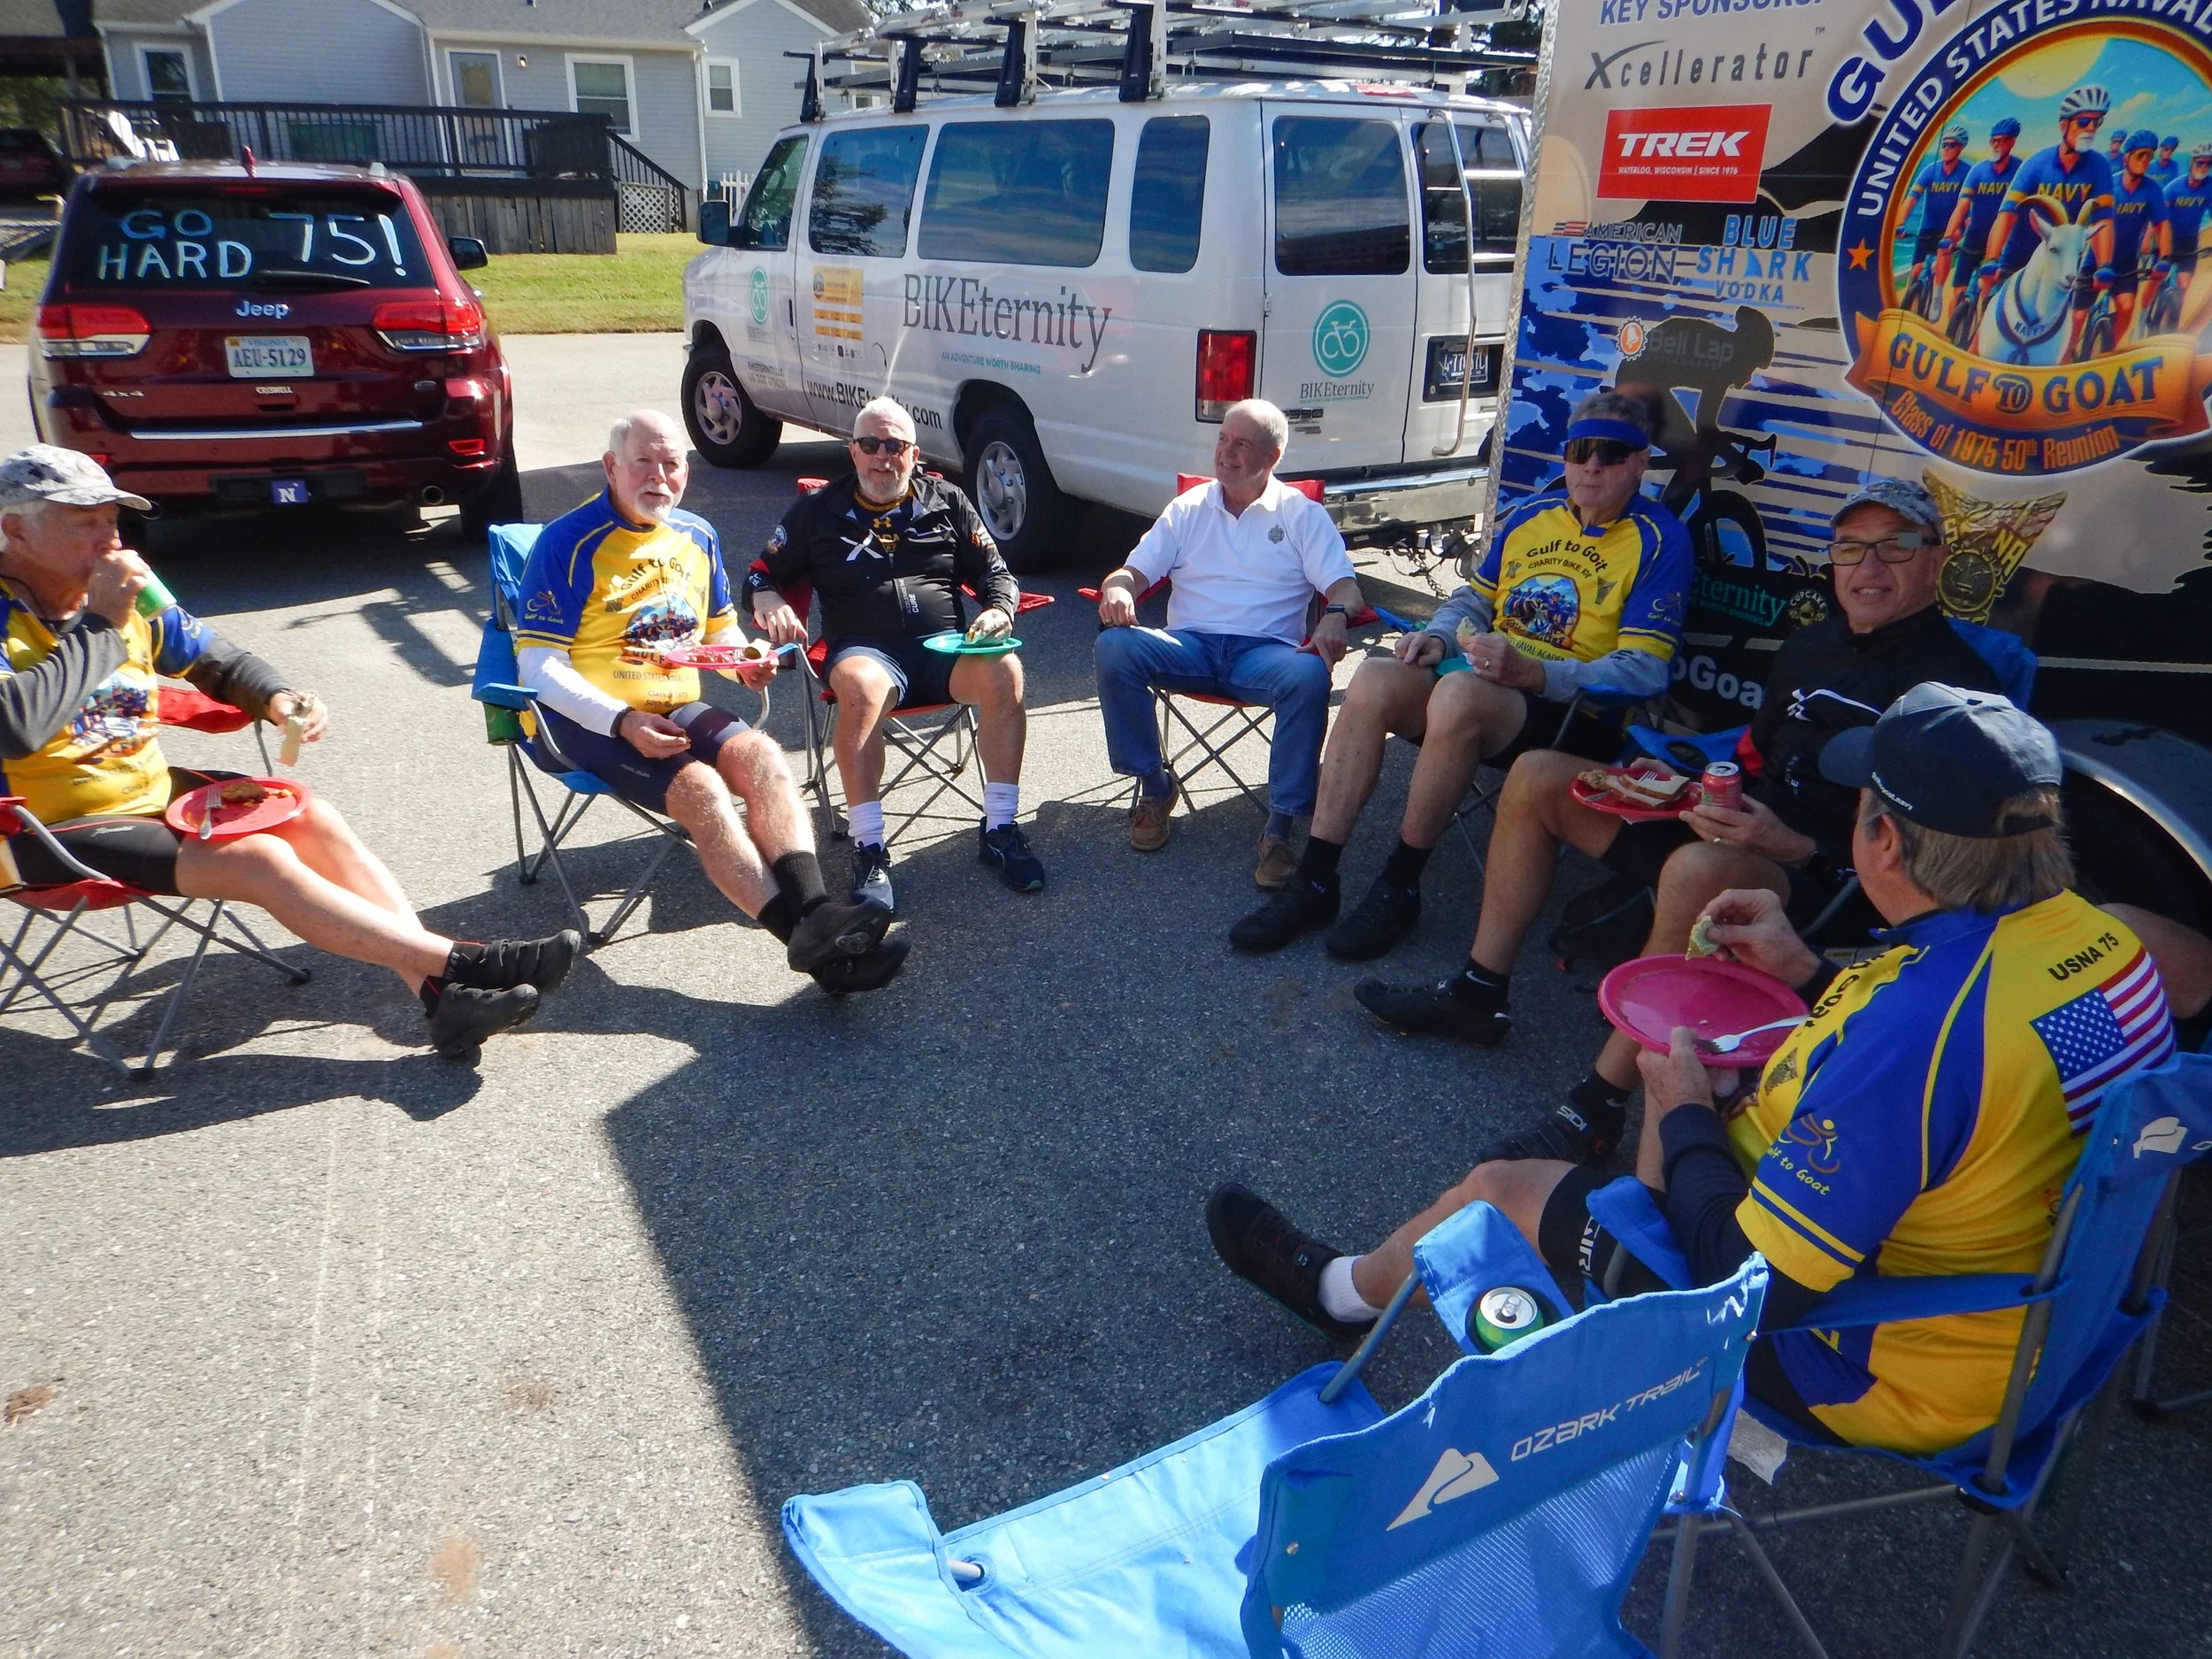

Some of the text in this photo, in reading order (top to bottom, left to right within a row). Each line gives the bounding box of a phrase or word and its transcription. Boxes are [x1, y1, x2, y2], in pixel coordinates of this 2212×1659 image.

[1600, 0, 1647, 25] KEY
[1584, 41, 1813, 89] Xcellerator
[1857, 76, 1943, 216] UNITED
[1947, 0, 2078, 80] STATES
[1617, 131, 1750, 157] TREK
[1618, 165, 1739, 176] WATERLOO, WISCONSIN SINCE 1976
[1931, 180, 1961, 193] NAVY
[2037, 181, 2093, 204] NAVY
[119, 208, 213, 239] GO
[1584, 219, 1683, 245] AMERICAN
[1722, 213, 1798, 251] BLUE
[268, 213, 408, 278] 75!
[97, 239, 253, 280] HARD
[1547, 239, 1678, 285] LEGION
[1714, 279, 1785, 303] VODKA
[235, 300, 290, 319] Jeep
[902, 273, 1113, 373] BIKEternity
[234, 347, 306, 368] AEU-5129
[1647, 327, 1690, 357] Bell
[1694, 333, 1735, 368] Lap
[950, 353, 985, 366] ADVENTURE
[985, 358, 1009, 369] WORTH
[1010, 361, 1041, 374] SHARING
[1888, 331, 2164, 415] GULF TO GOAT
[1300, 380, 1375, 399] BIKEternity
[1889, 389, 1935, 440] Class
[1932, 423, 1953, 449] of
[1950, 428, 2001, 469] 1975
[2042, 425, 2122, 470] Reunion
[277, 487, 297, 503] N
[1526, 539, 1563, 558] Gulf
[1564, 540, 1581, 553] to
[620, 562, 647, 591] Gulf
[1527, 557, 1563, 570] CHARITY
[1563, 559, 1583, 572] BIKE
[631, 578, 660, 601] CHARITY
[1789, 590, 1827, 611] CUPCAKE
[908, 594, 920, 614] CURE
[612, 669, 642, 680] UNITED
[642, 672, 666, 682] STATES
[2047, 932, 2119, 981] USNA 75
[1767, 1147, 1832, 1195] ulf to Goat
